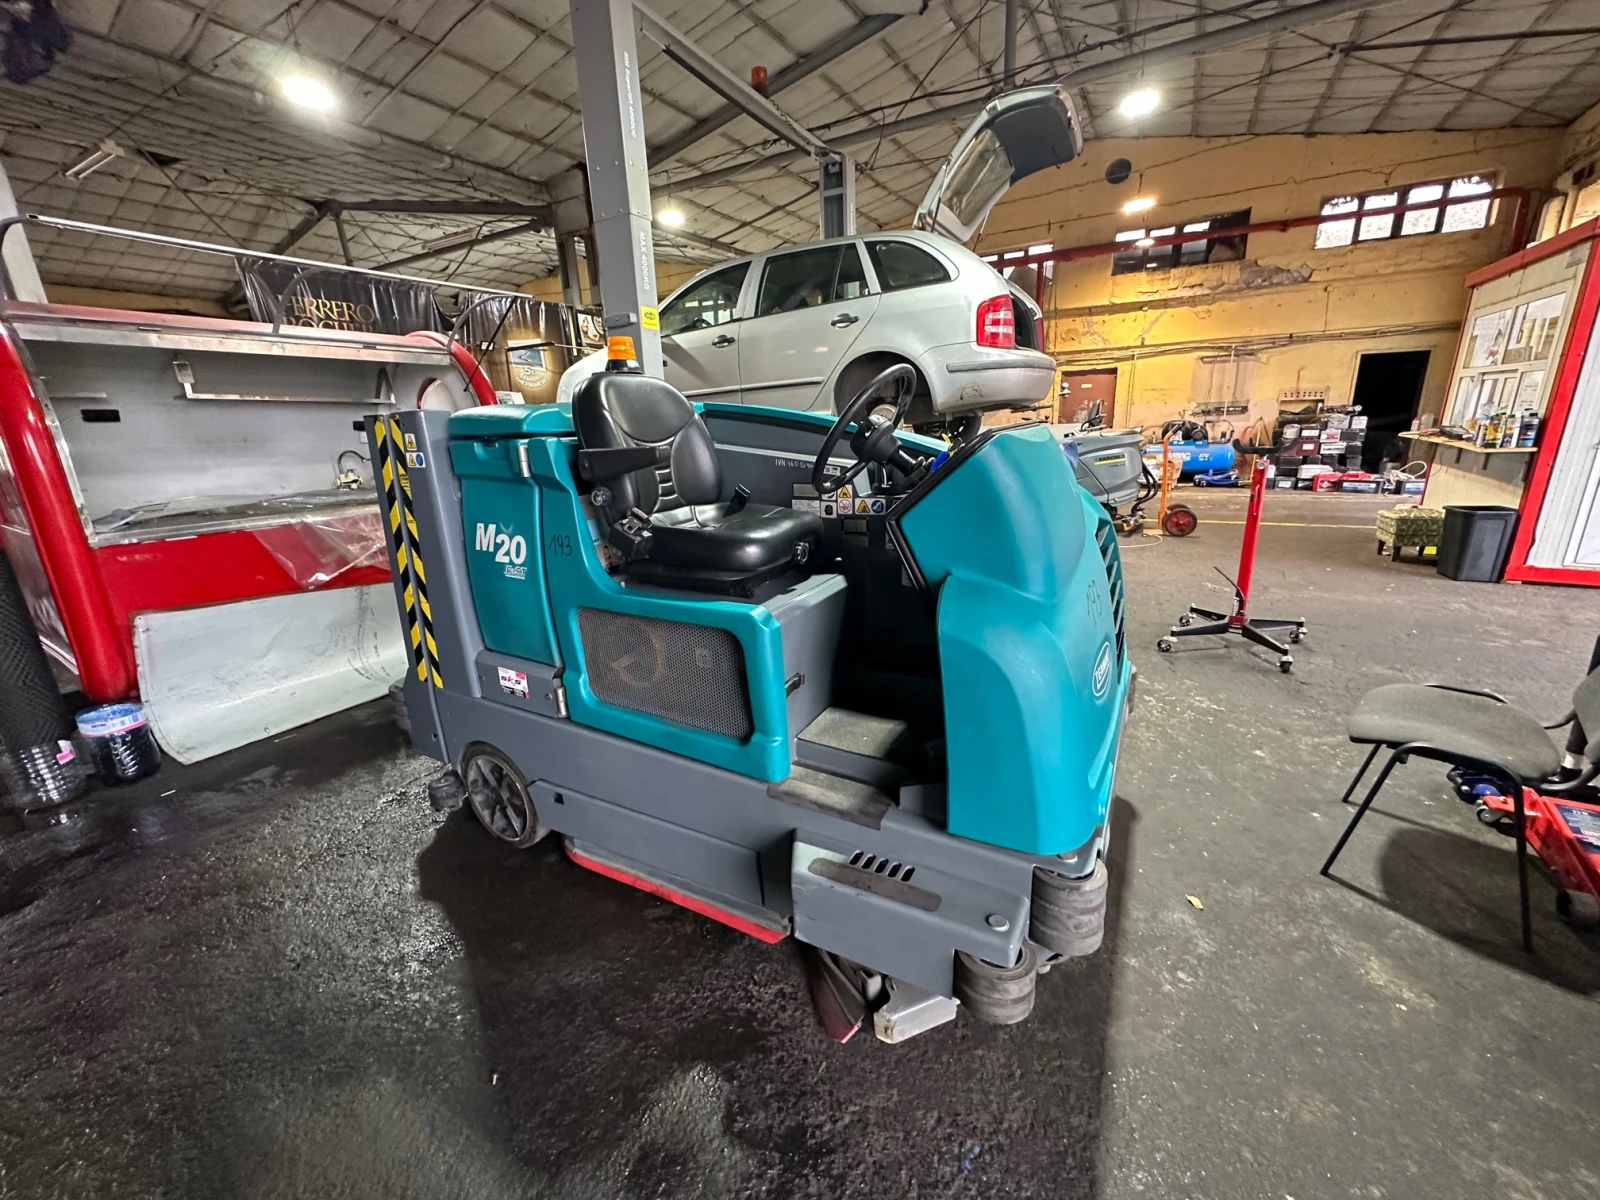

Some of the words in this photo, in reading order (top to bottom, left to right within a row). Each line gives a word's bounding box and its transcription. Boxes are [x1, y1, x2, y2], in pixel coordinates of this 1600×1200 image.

[641, 254, 650, 290] 4000KG
[475, 522, 527, 565] M20
[548, 533, 573, 557] 193
